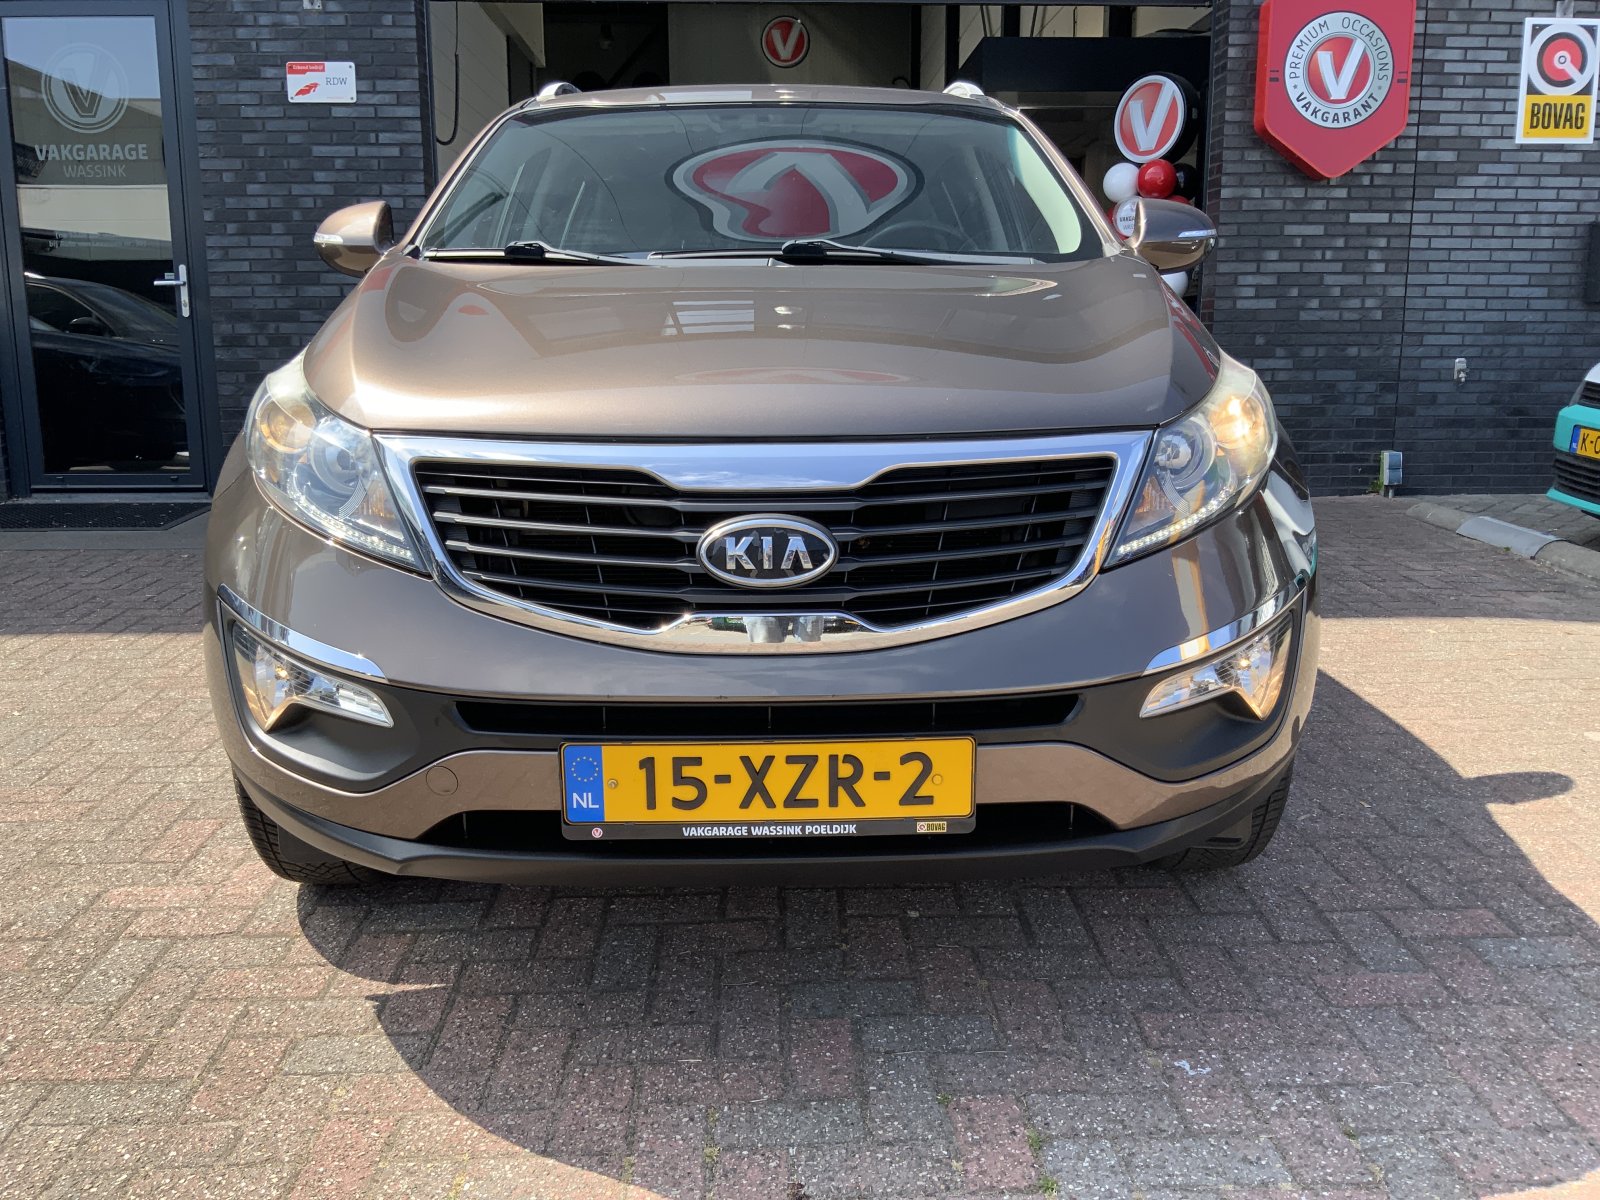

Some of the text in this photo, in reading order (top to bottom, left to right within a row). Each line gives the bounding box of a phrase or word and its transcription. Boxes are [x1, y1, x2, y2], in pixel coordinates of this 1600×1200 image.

[1288, 16, 1389, 82] PREMIUM OCCASIONS
[325, 76, 348, 86] RDW
[1316, 38, 1367, 100] V
[1128, 80, 1177, 152] V
[1295, 91, 1379, 124] VAKGARANT
[1529, 102, 1586, 130] BOVAG
[34, 143, 149, 161] VAKGARAGE
[63, 164, 127, 178] WASSINK
[723, 536, 814, 570] KIA
[638, 751, 936, 811] 15-XZR-2
[572, 792, 600, 809] NL
[682, 824, 857, 837] VAKGARAGE WASSINK POELDIJK
[926, 822, 946, 832] BOVAG
